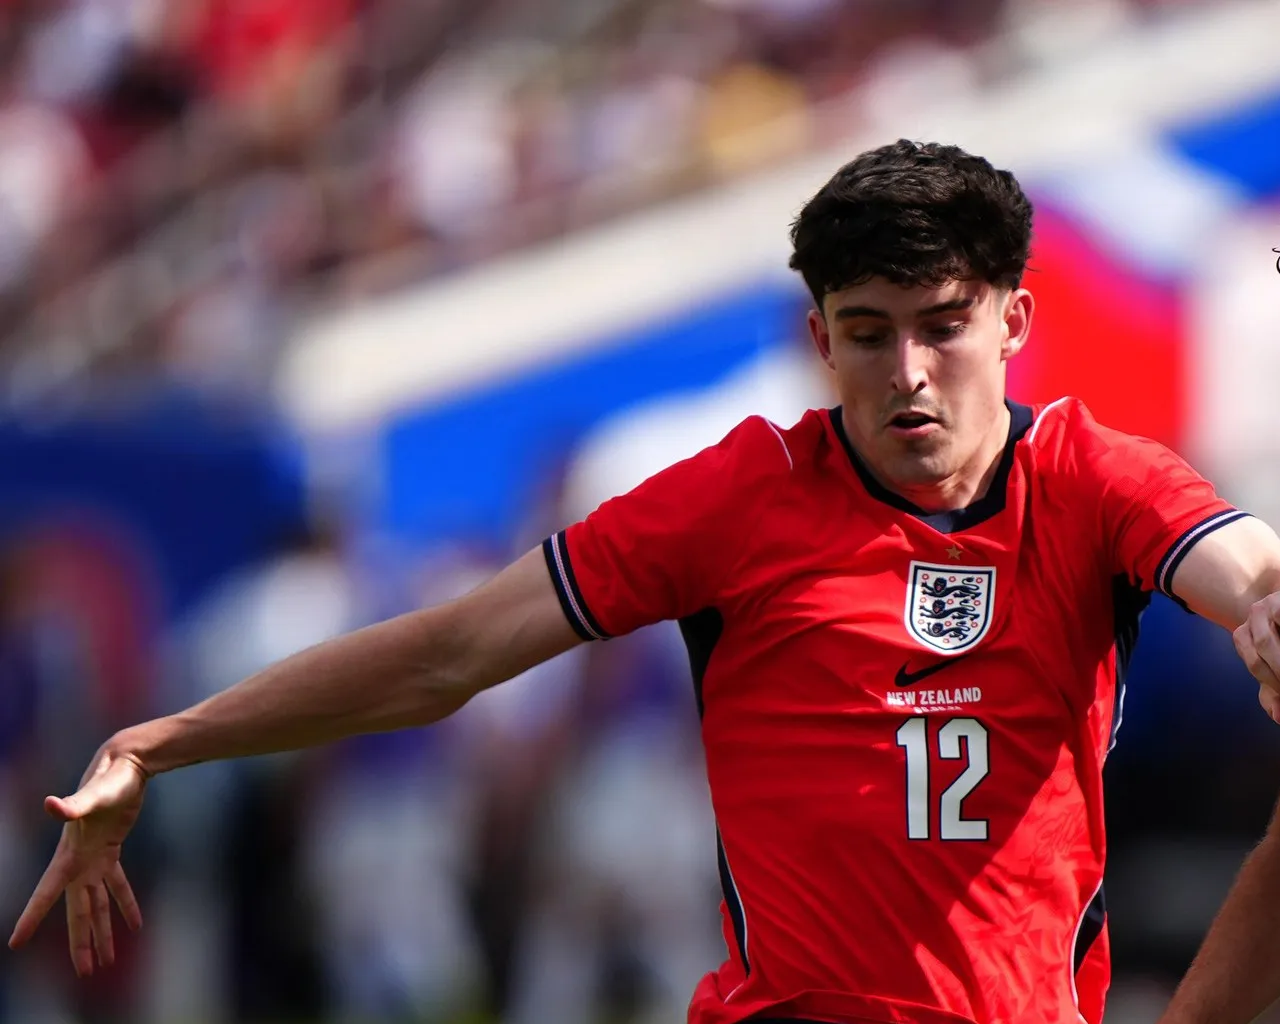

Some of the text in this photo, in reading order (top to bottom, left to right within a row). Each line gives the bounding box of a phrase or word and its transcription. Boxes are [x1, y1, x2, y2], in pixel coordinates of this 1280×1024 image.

[887, 687, 982, 705] NEW ZEALAND
[896, 716, 990, 841] 12
